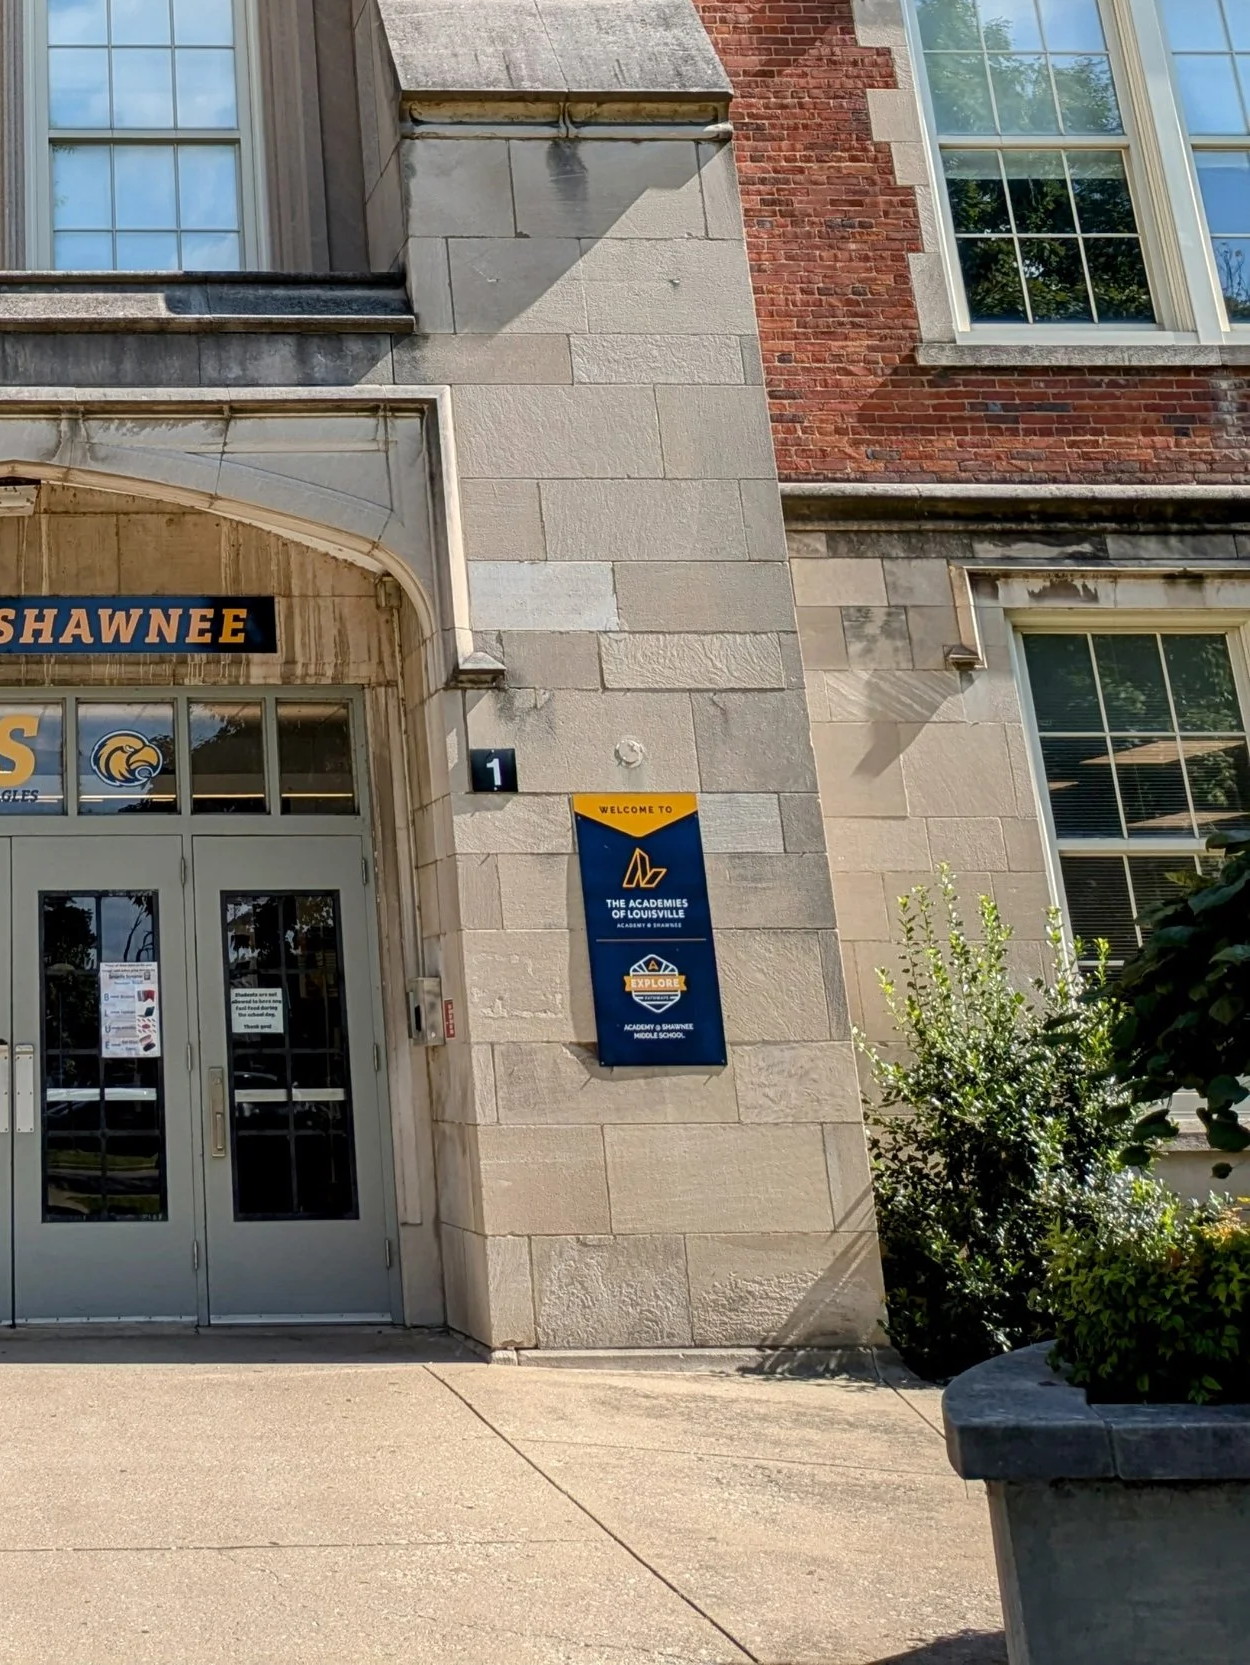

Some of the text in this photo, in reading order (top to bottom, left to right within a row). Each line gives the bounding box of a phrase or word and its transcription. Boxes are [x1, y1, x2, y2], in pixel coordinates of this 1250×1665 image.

[486, 757, 502, 786] 1
[599, 805, 673, 814] WELCOME TO
[606, 898, 689, 908] THE ACADEMIES
[612, 909, 686, 919] OF LOUISVILLE
[631, 978, 680, 988] EXPLORE
[624, 1023, 655, 1031] ACADEMY
